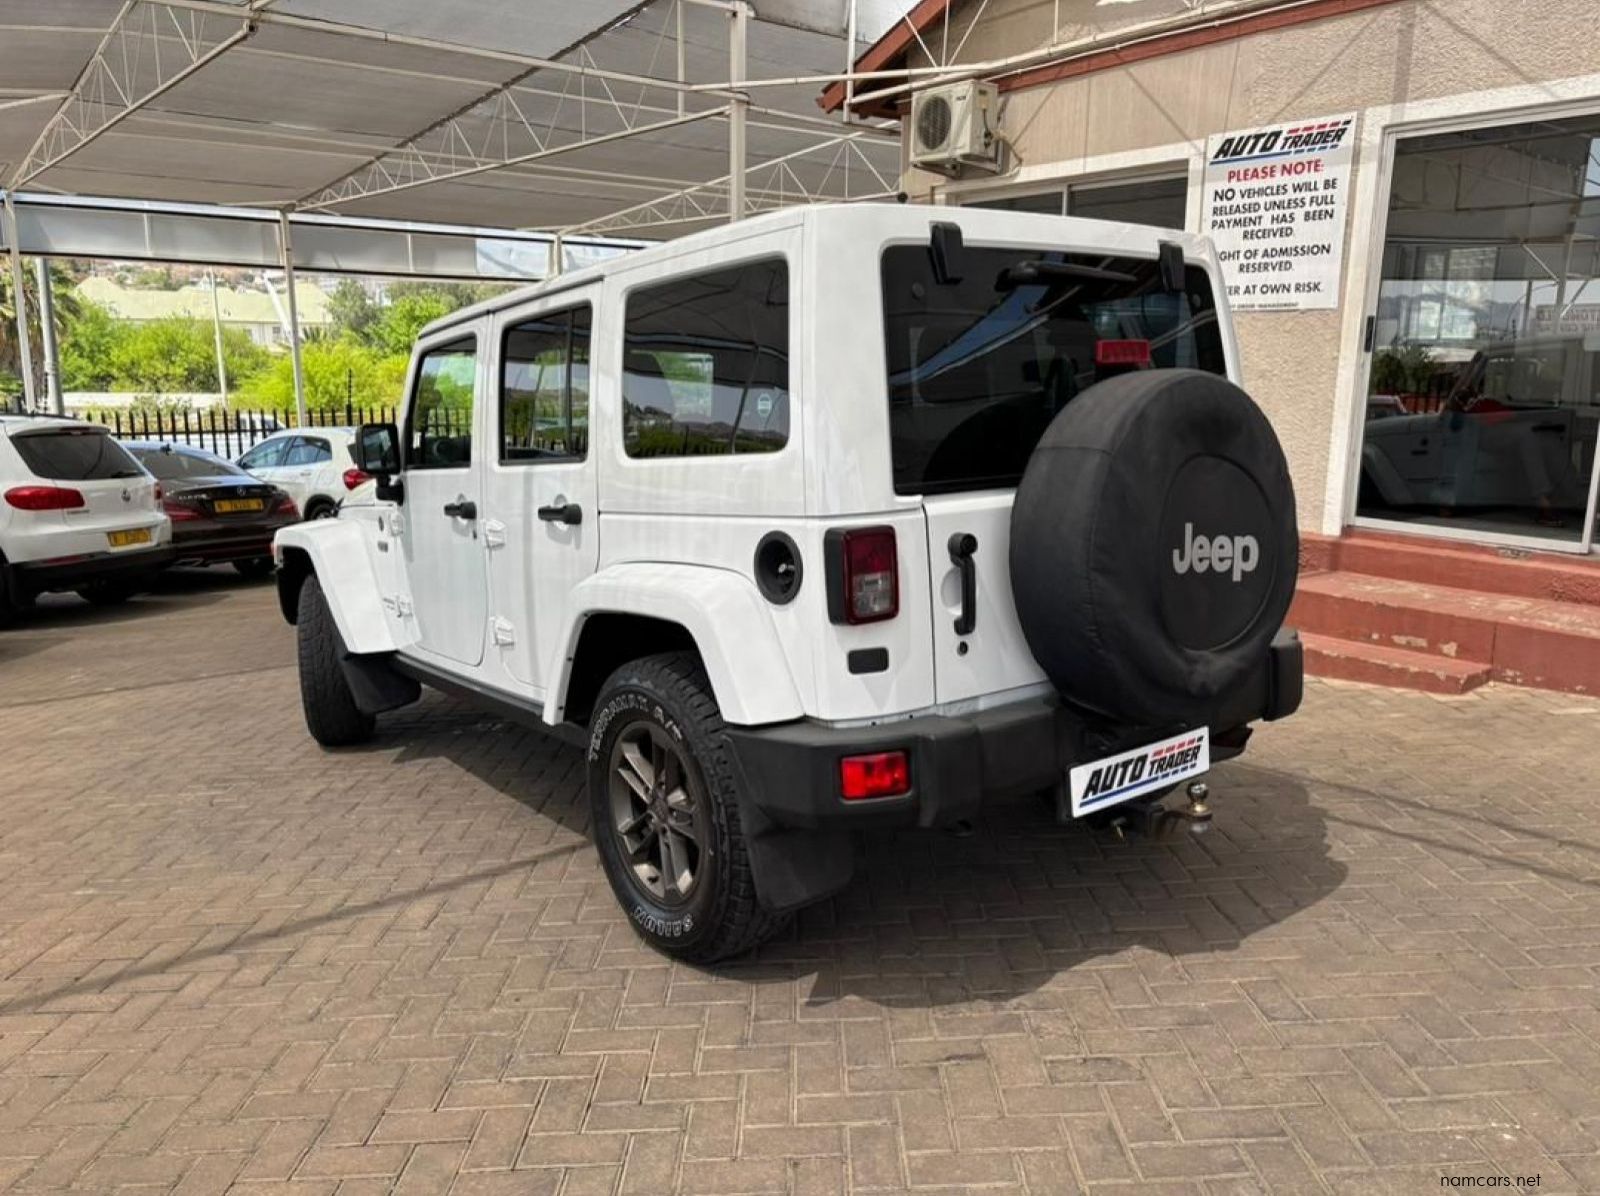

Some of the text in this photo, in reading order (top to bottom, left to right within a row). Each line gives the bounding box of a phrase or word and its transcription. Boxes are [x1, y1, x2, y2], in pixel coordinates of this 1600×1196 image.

[1213, 127, 1348, 159] AUTO TRADER
[1228, 165, 1276, 183] PLEASE
[1214, 178, 1338, 202] NO VEHICLES WILL BE
[1212, 194, 1336, 217] RELEASED UNLESS FULL
[1211, 208, 1334, 229] PAYMENT HAS BEEN
[1218, 243, 1331, 262] GHT OF ADMISSION
[1243, 284, 1257, 295] AT
[1260, 283, 1291, 295] OWN
[1173, 522, 1259, 582] Jeep
[1082, 745, 1202, 800] AUTO TRADER
